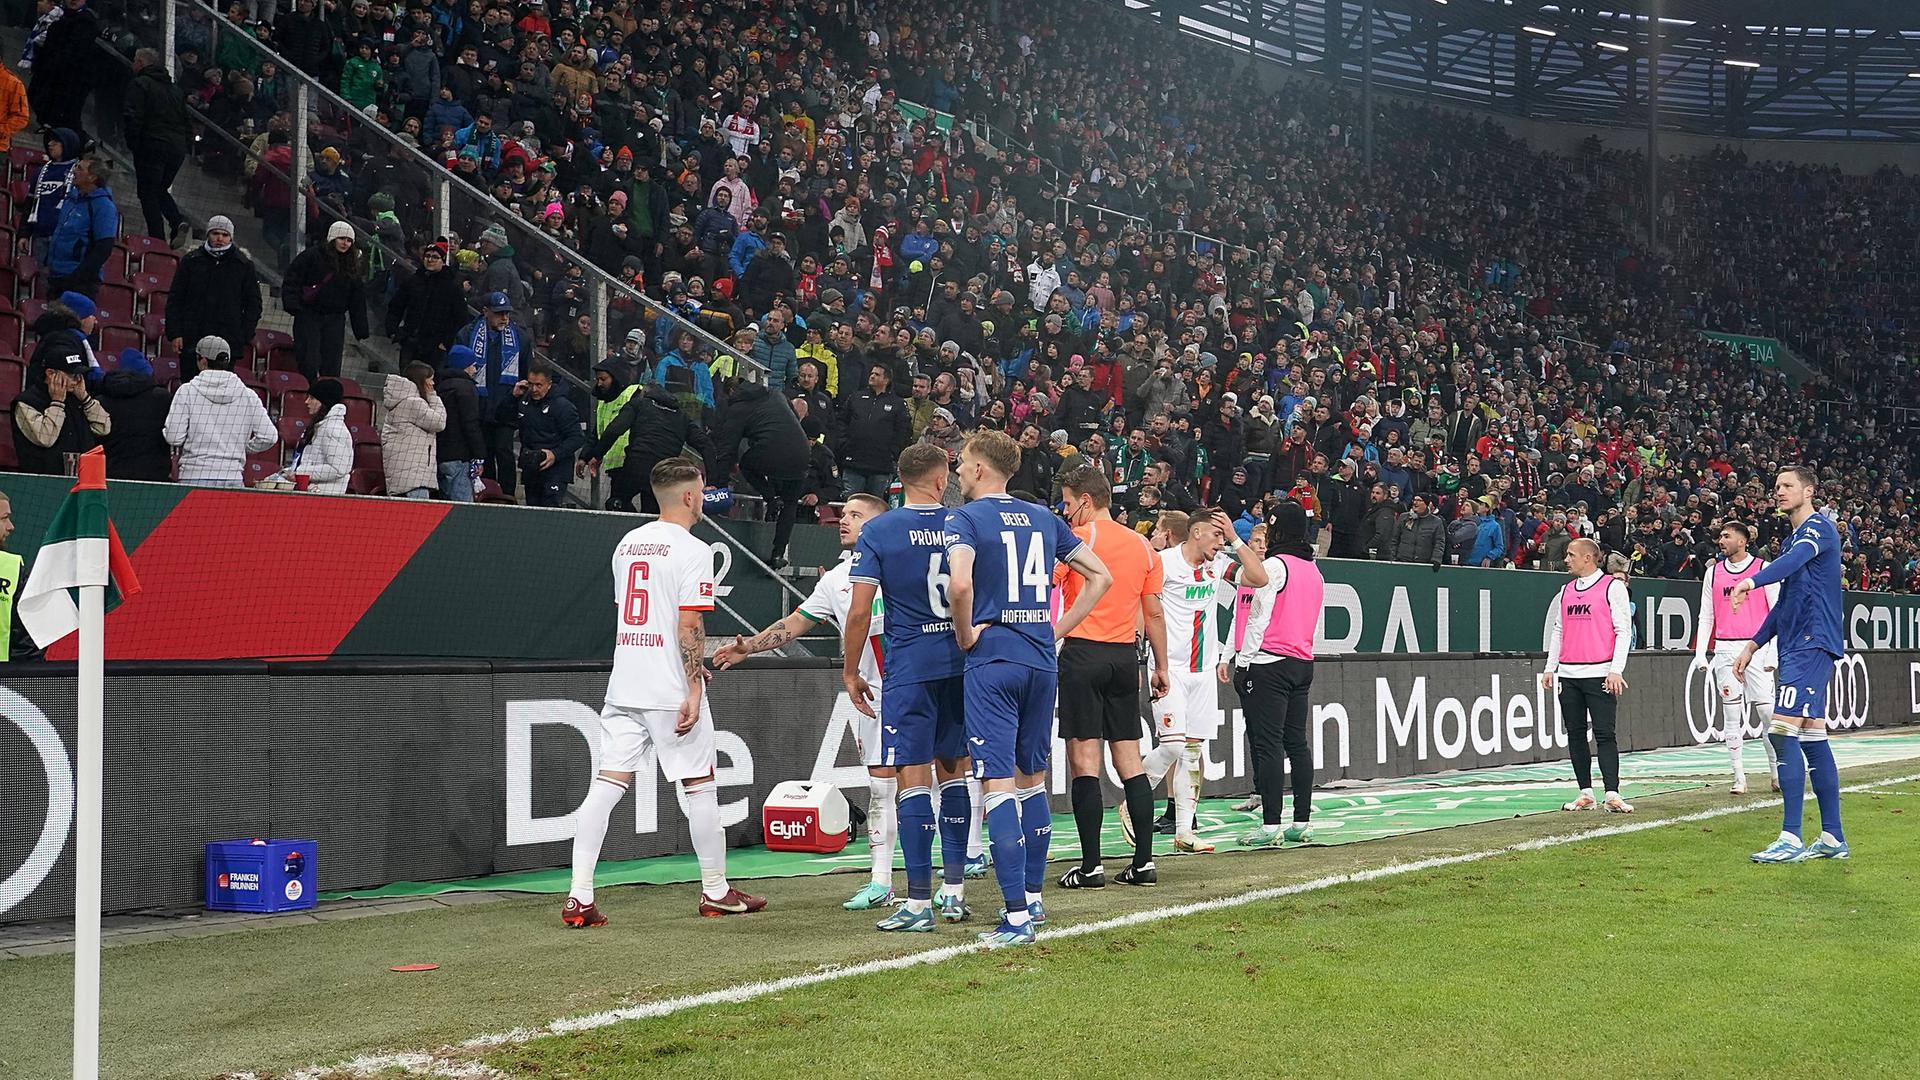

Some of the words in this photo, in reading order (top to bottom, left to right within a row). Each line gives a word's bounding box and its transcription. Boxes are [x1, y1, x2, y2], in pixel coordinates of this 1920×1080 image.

[1731, 341, 1774, 362] AENA
[1000, 511, 1031, 526] BEIER
[626, 543, 671, 557] AUGSBURG
[1000, 531, 1050, 603] 14
[623, 561, 650, 626] 6
[927, 552, 952, 619] 6
[1567, 604, 1591, 616] WWK
[616, 632, 664, 648] UWELEEUW
[1778, 685, 1797, 709] 10
[1376, 673, 1593, 764] Modell
[922, 823, 937, 832] TS
[943, 816, 965, 824] TSG
[769, 820, 807, 840] Elyth
[230, 872, 259, 883] FRANKEN
[230, 881, 259, 891] BRUNNEN
